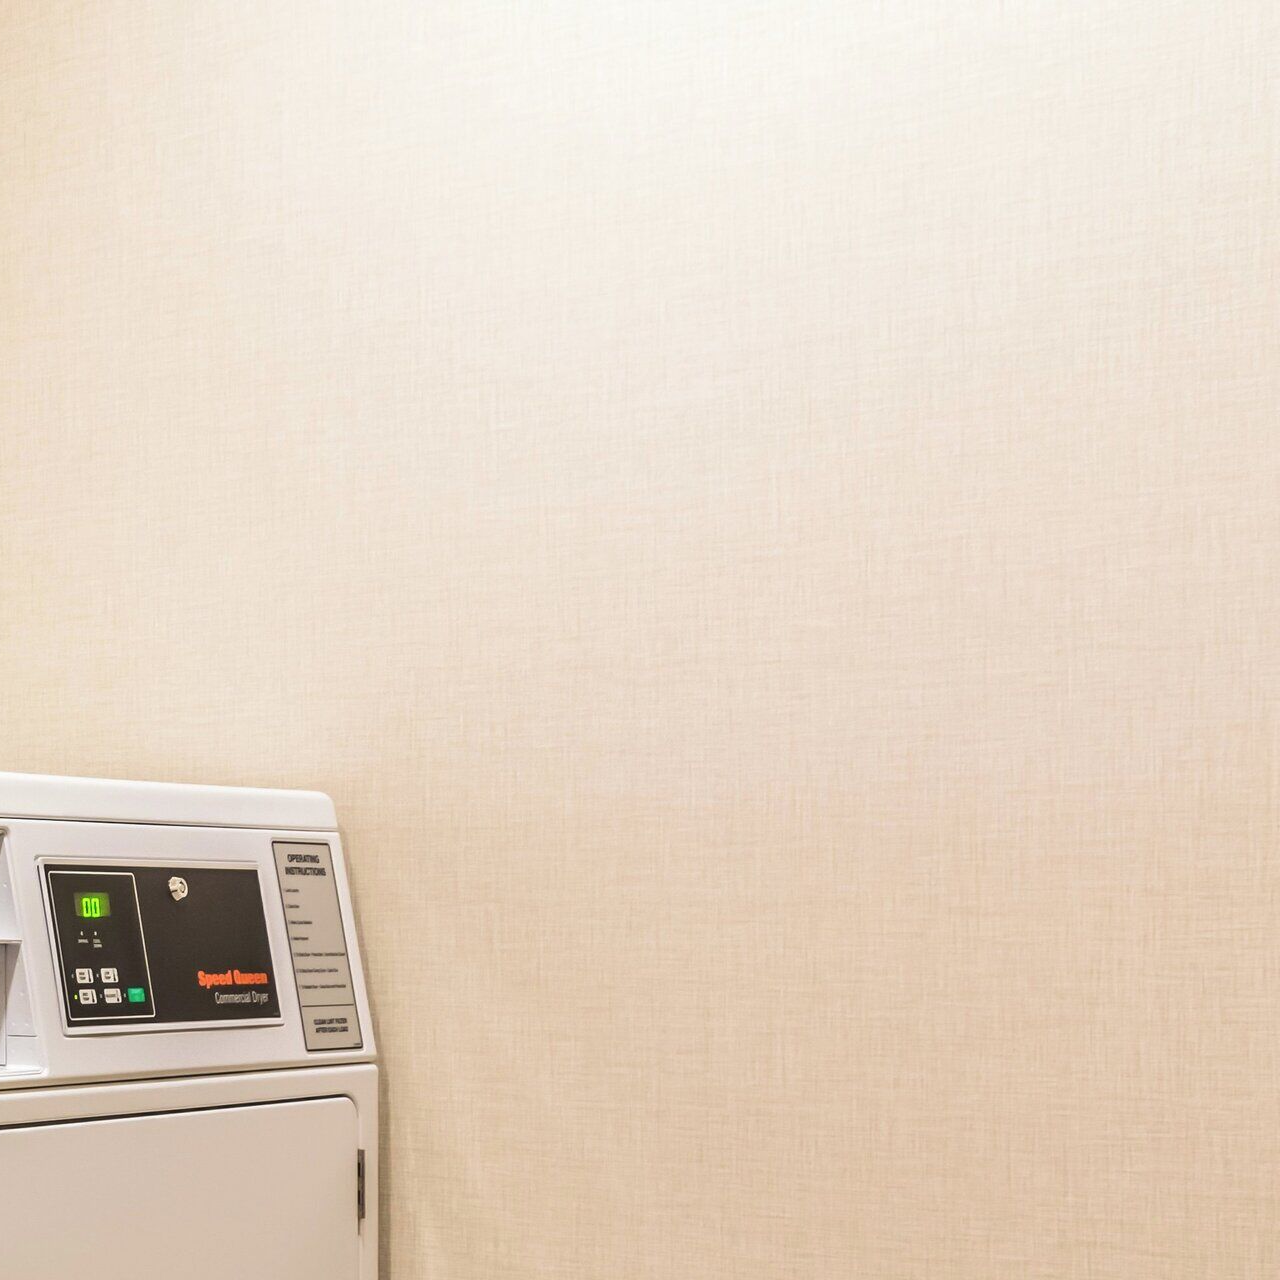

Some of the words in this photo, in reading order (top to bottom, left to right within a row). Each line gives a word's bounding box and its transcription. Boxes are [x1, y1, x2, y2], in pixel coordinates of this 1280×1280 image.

[287, 854, 320, 864] OPERATING
[285, 867, 326, 876] INSTRUCTIONS
[197, 970, 233, 989] Speed
[233, 969, 268, 985] Queen
[215, 991, 251, 1004] Commercial
[252, 991, 269, 1005] Dryer
